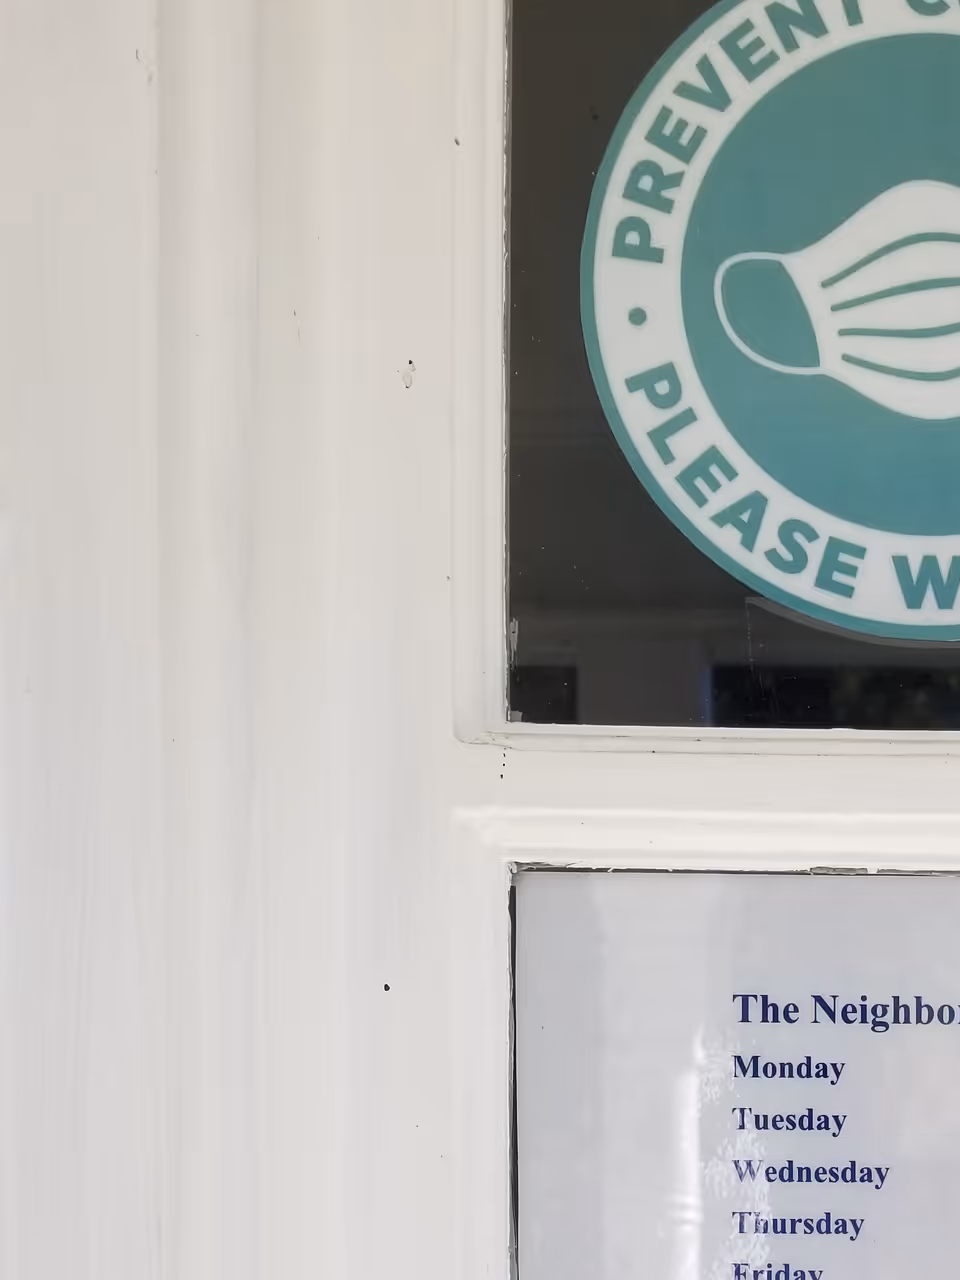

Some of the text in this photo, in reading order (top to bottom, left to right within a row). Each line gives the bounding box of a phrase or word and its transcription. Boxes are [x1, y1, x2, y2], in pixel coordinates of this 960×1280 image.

[625, 362, 867, 600] PLEASE
[731, 993, 799, 1024] The
[731, 1054, 846, 1085] Monday
[731, 1107, 847, 1137] Tuesday
[731, 1159, 890, 1190] Wednesday
[731, 1211, 865, 1241] Thursday
